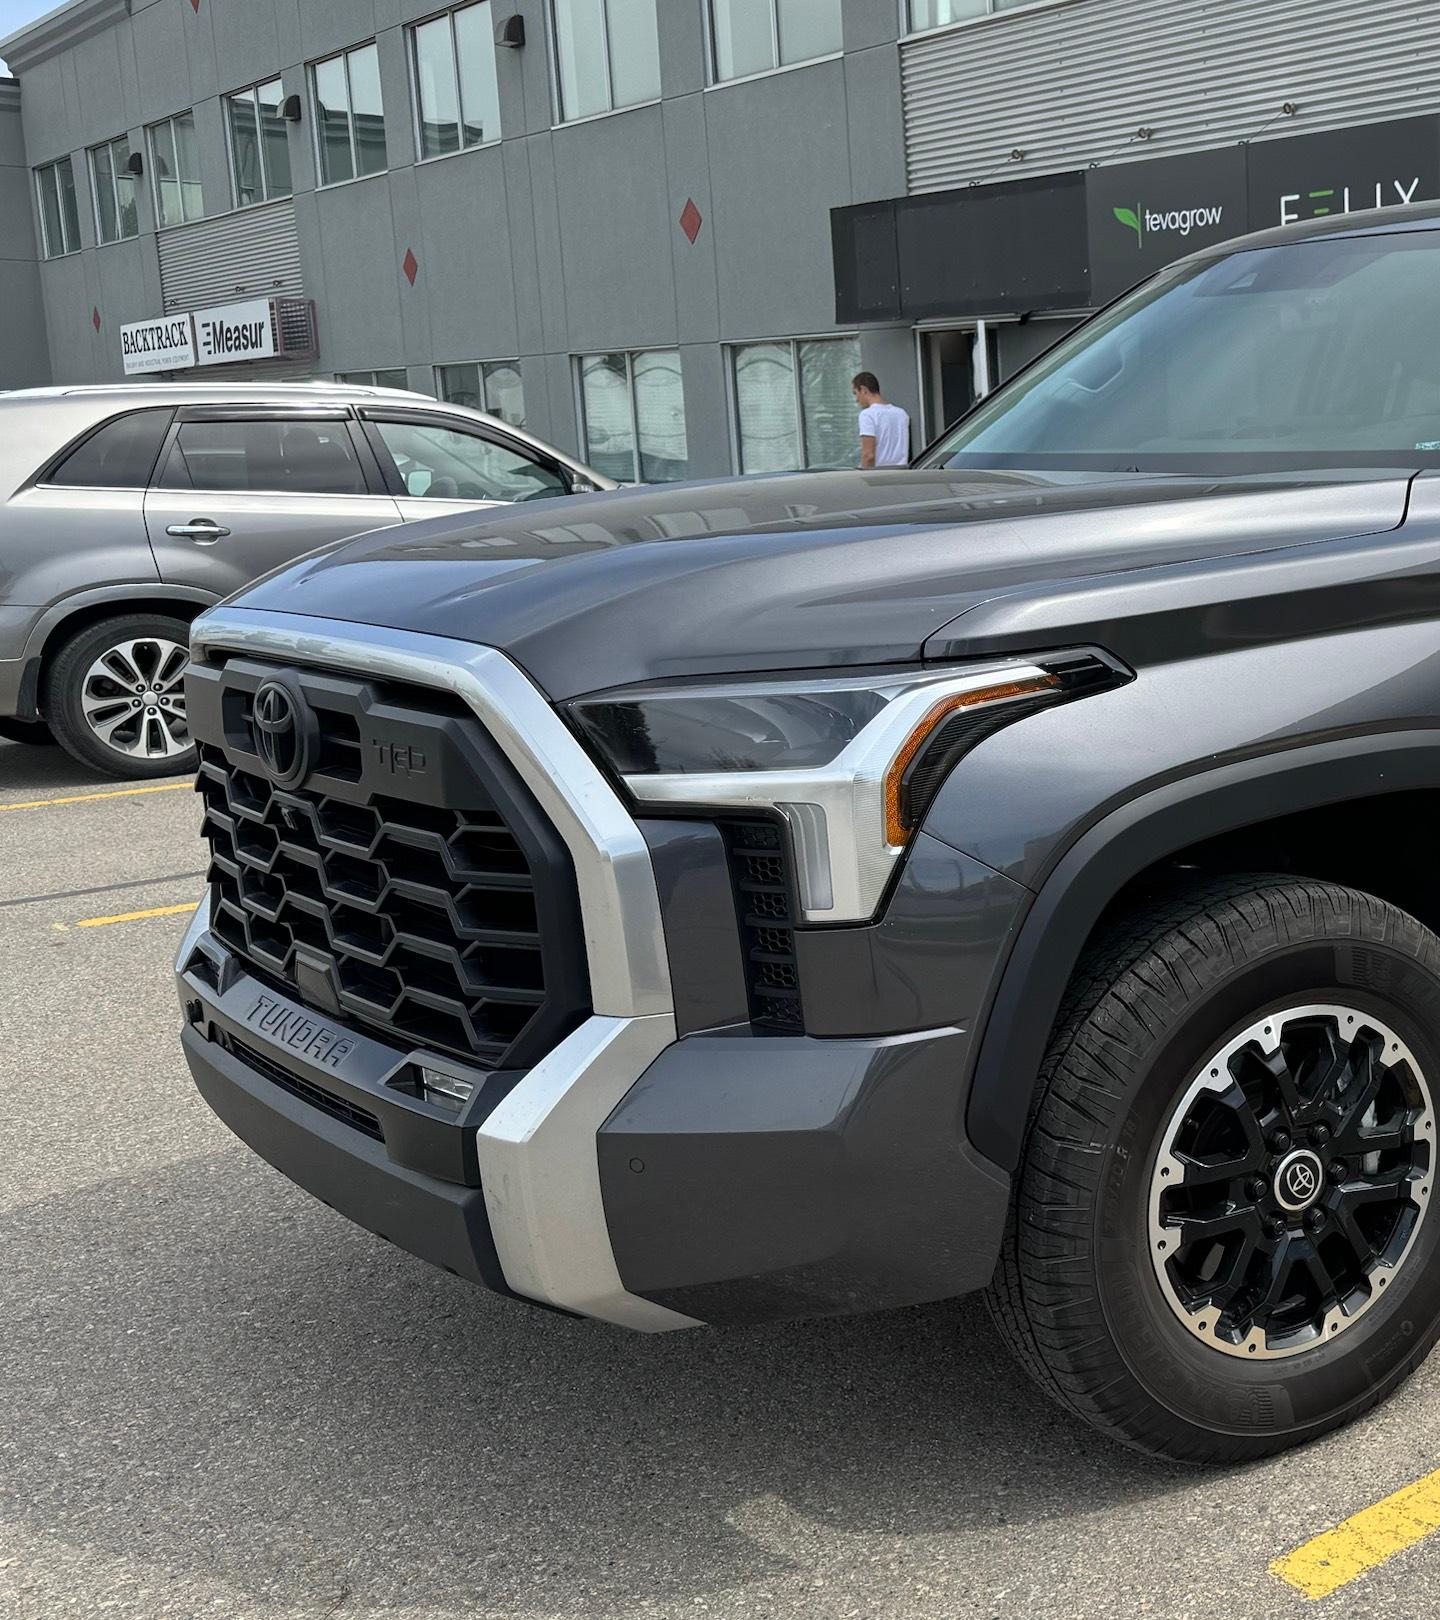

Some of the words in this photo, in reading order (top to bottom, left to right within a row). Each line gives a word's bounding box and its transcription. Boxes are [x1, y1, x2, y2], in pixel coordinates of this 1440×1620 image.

[1144, 205, 1223, 236] tevagrow
[122, 321, 189, 356] BACKTRACK
[212, 319, 265, 354] Measur
[372, 738, 428, 779] TRD
[246, 994, 359, 1068] TUNDRA
